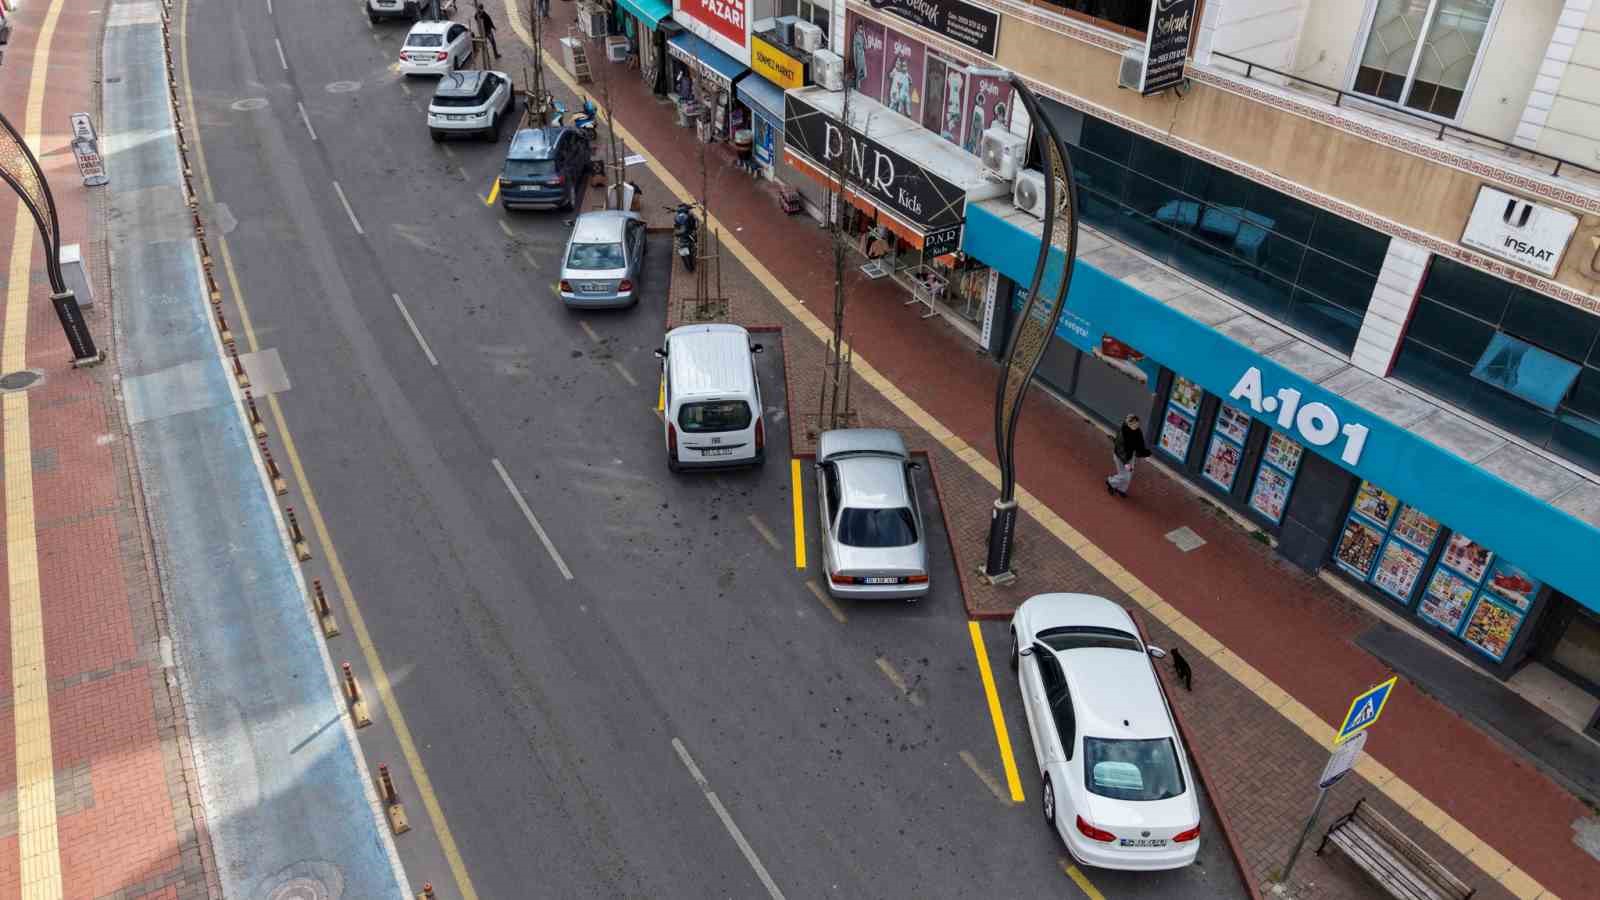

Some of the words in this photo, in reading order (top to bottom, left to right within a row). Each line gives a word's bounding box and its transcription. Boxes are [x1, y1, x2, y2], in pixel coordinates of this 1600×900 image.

[775, 63, 795, 81] MARKET
[898, 187, 923, 216] Kids
[1229, 366, 1369, 467] A.101
